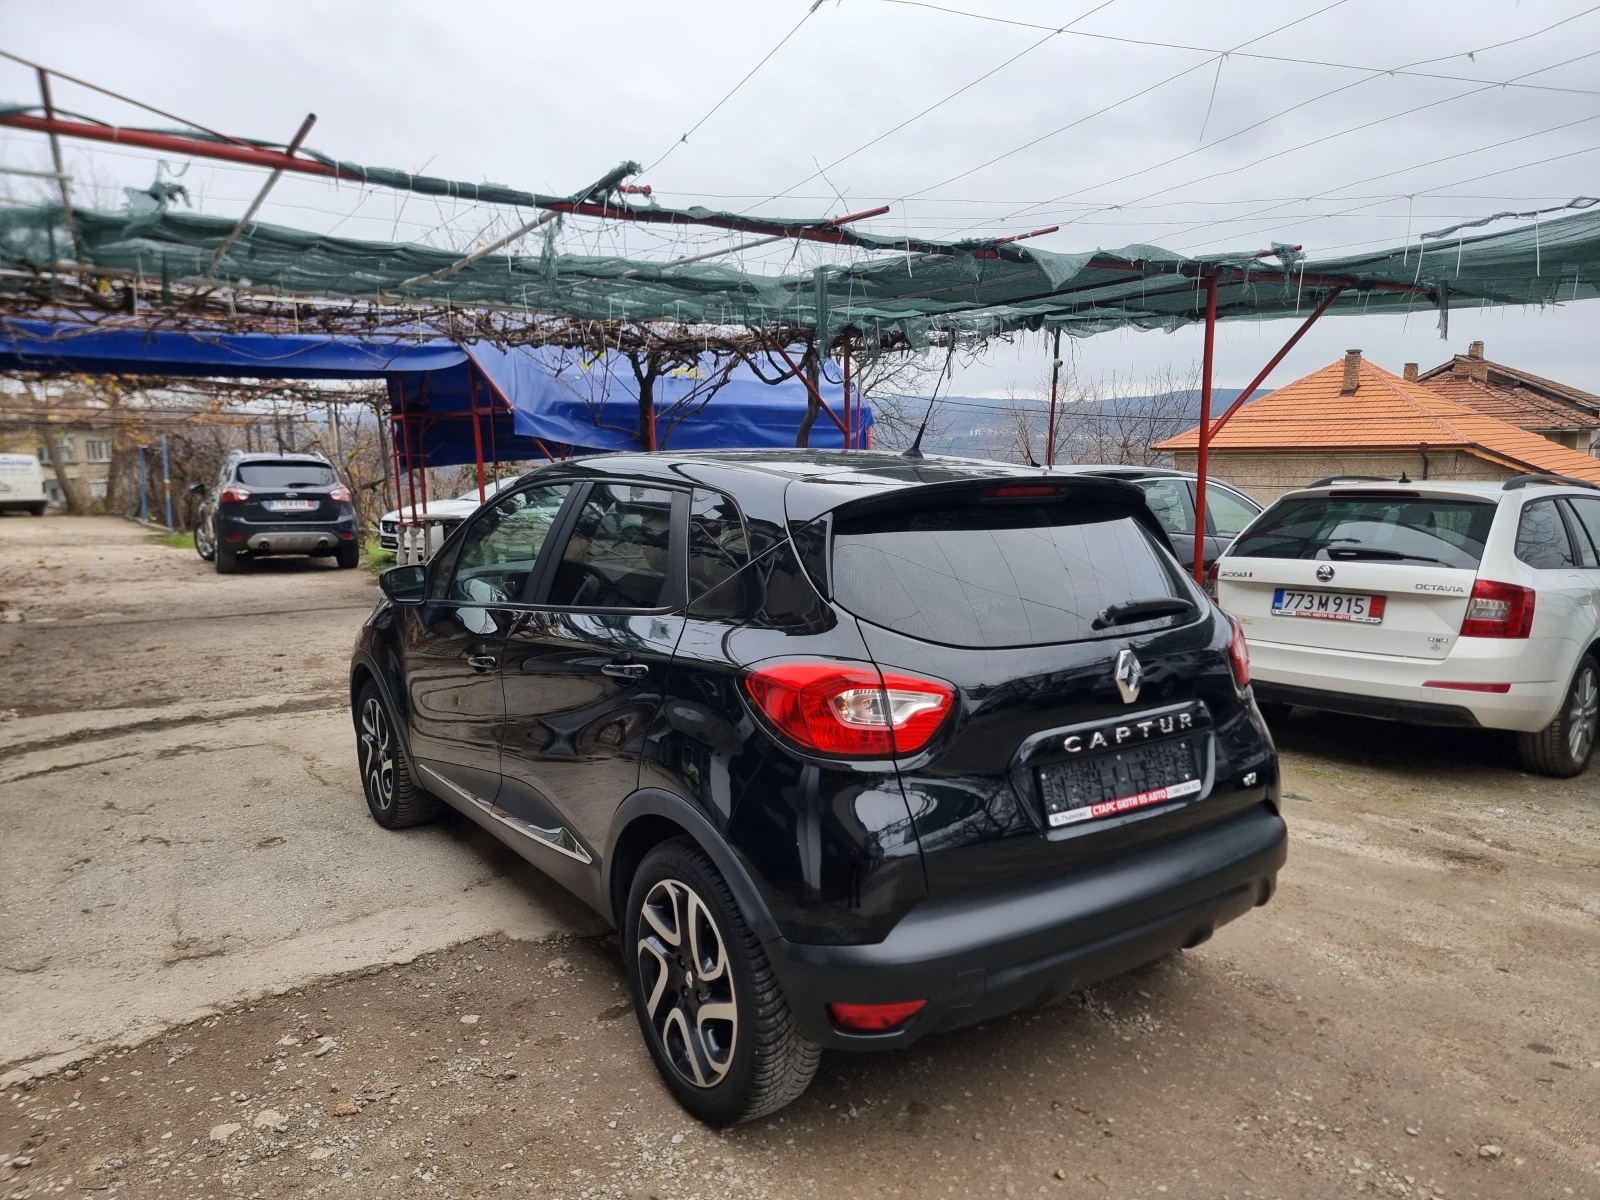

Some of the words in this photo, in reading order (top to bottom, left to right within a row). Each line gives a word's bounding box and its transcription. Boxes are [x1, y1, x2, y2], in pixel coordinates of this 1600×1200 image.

[1415, 583, 1465, 593] OCTAVIA
[1063, 712, 1193, 753] CAPTUR
[1092, 801, 1117, 816] СТАРС
[1148, 789, 1167, 802] АВТО
